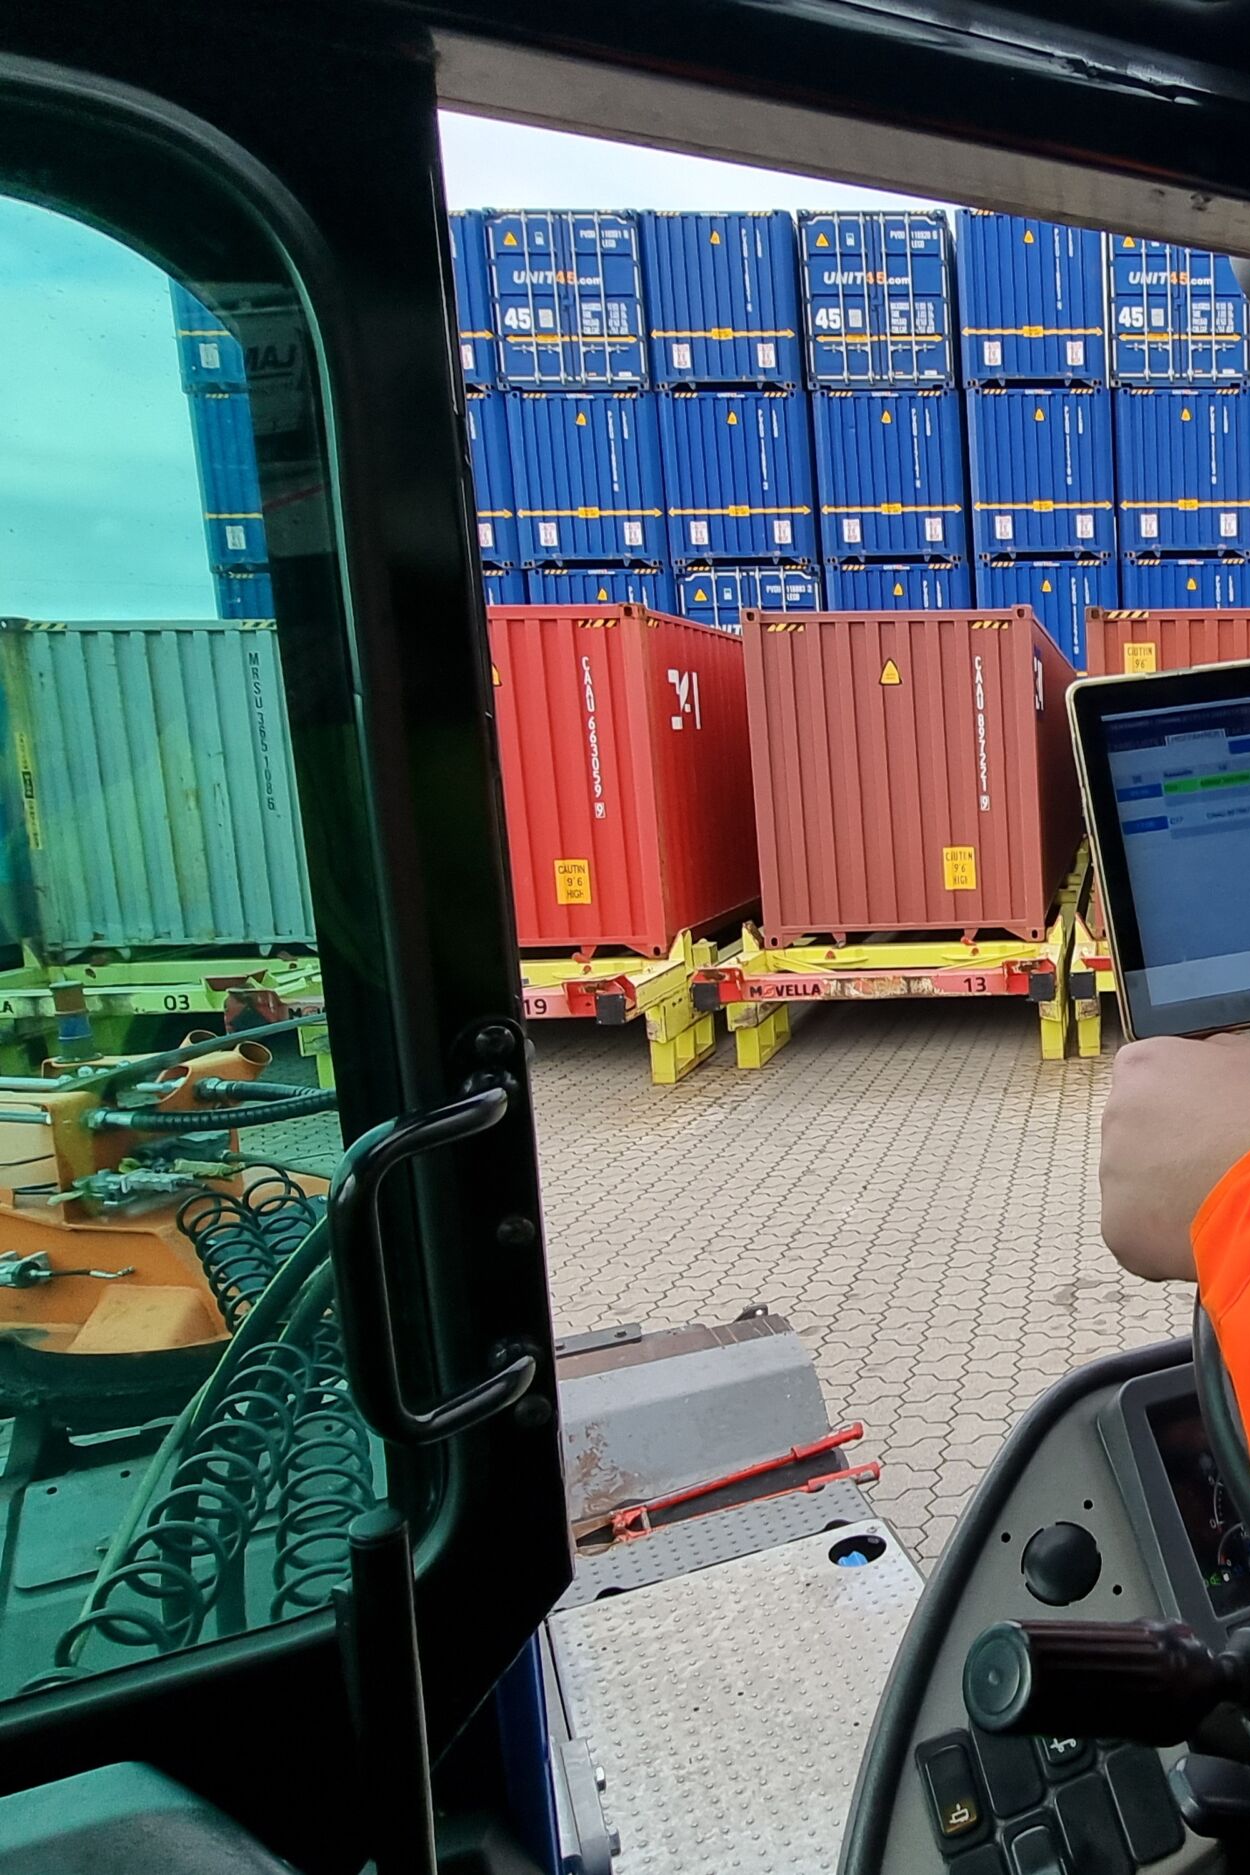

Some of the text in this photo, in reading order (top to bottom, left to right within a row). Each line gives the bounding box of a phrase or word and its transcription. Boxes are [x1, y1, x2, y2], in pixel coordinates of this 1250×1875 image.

[504, 307, 531, 329] 45
[815, 307, 841, 329] 45
[1119, 306, 1144, 327] 45
[581, 656, 605, 817] CAAU 663059 9
[974, 656, 989, 810] CAAU 897221 9
[750, 983, 821, 998] MOVELLA
[963, 976, 986, 994] 13
[163, 994, 190, 1011] 03
[523, 998, 547, 1015] 19
